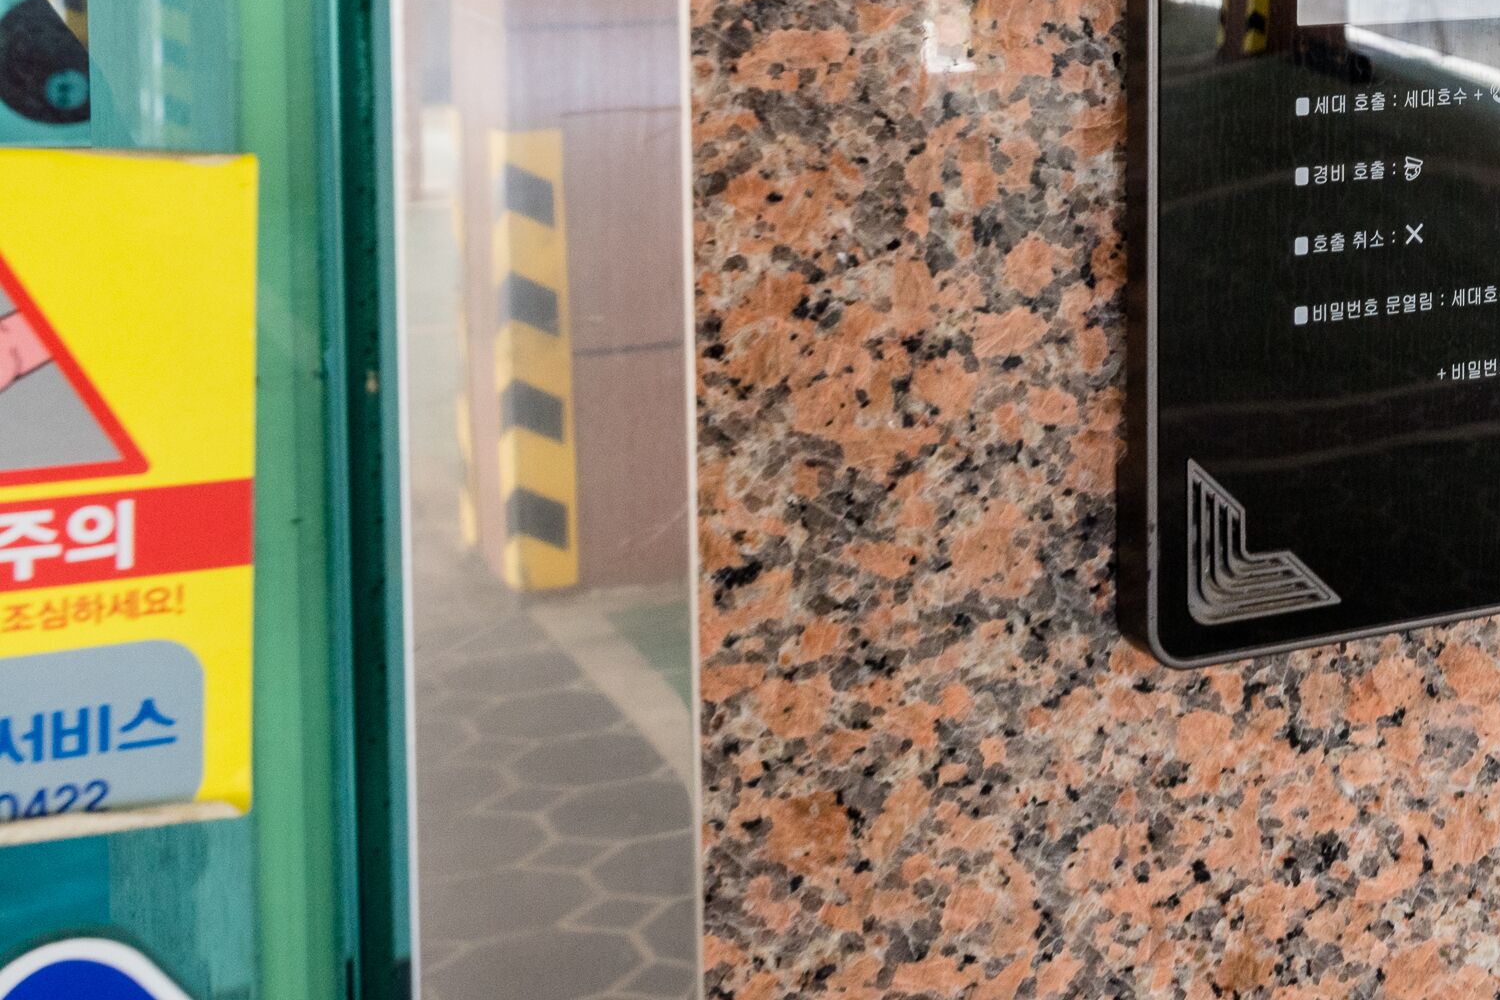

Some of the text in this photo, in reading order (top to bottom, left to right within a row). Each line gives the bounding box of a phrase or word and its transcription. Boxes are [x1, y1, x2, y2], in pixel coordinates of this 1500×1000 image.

[1314, 94, 1346, 115] 세대
[1354, 91, 1386, 112] 호출
[1404, 87, 1468, 109] 세대호수
[1313, 164, 1345, 185] 경비
[1353, 160, 1385, 182] 호출
[1313, 232, 1345, 254] 호출
[1353, 229, 1385, 250] 취소
[1313, 298, 1378, 323] 비밀번호
[1386, 291, 1433, 314] 문열림
